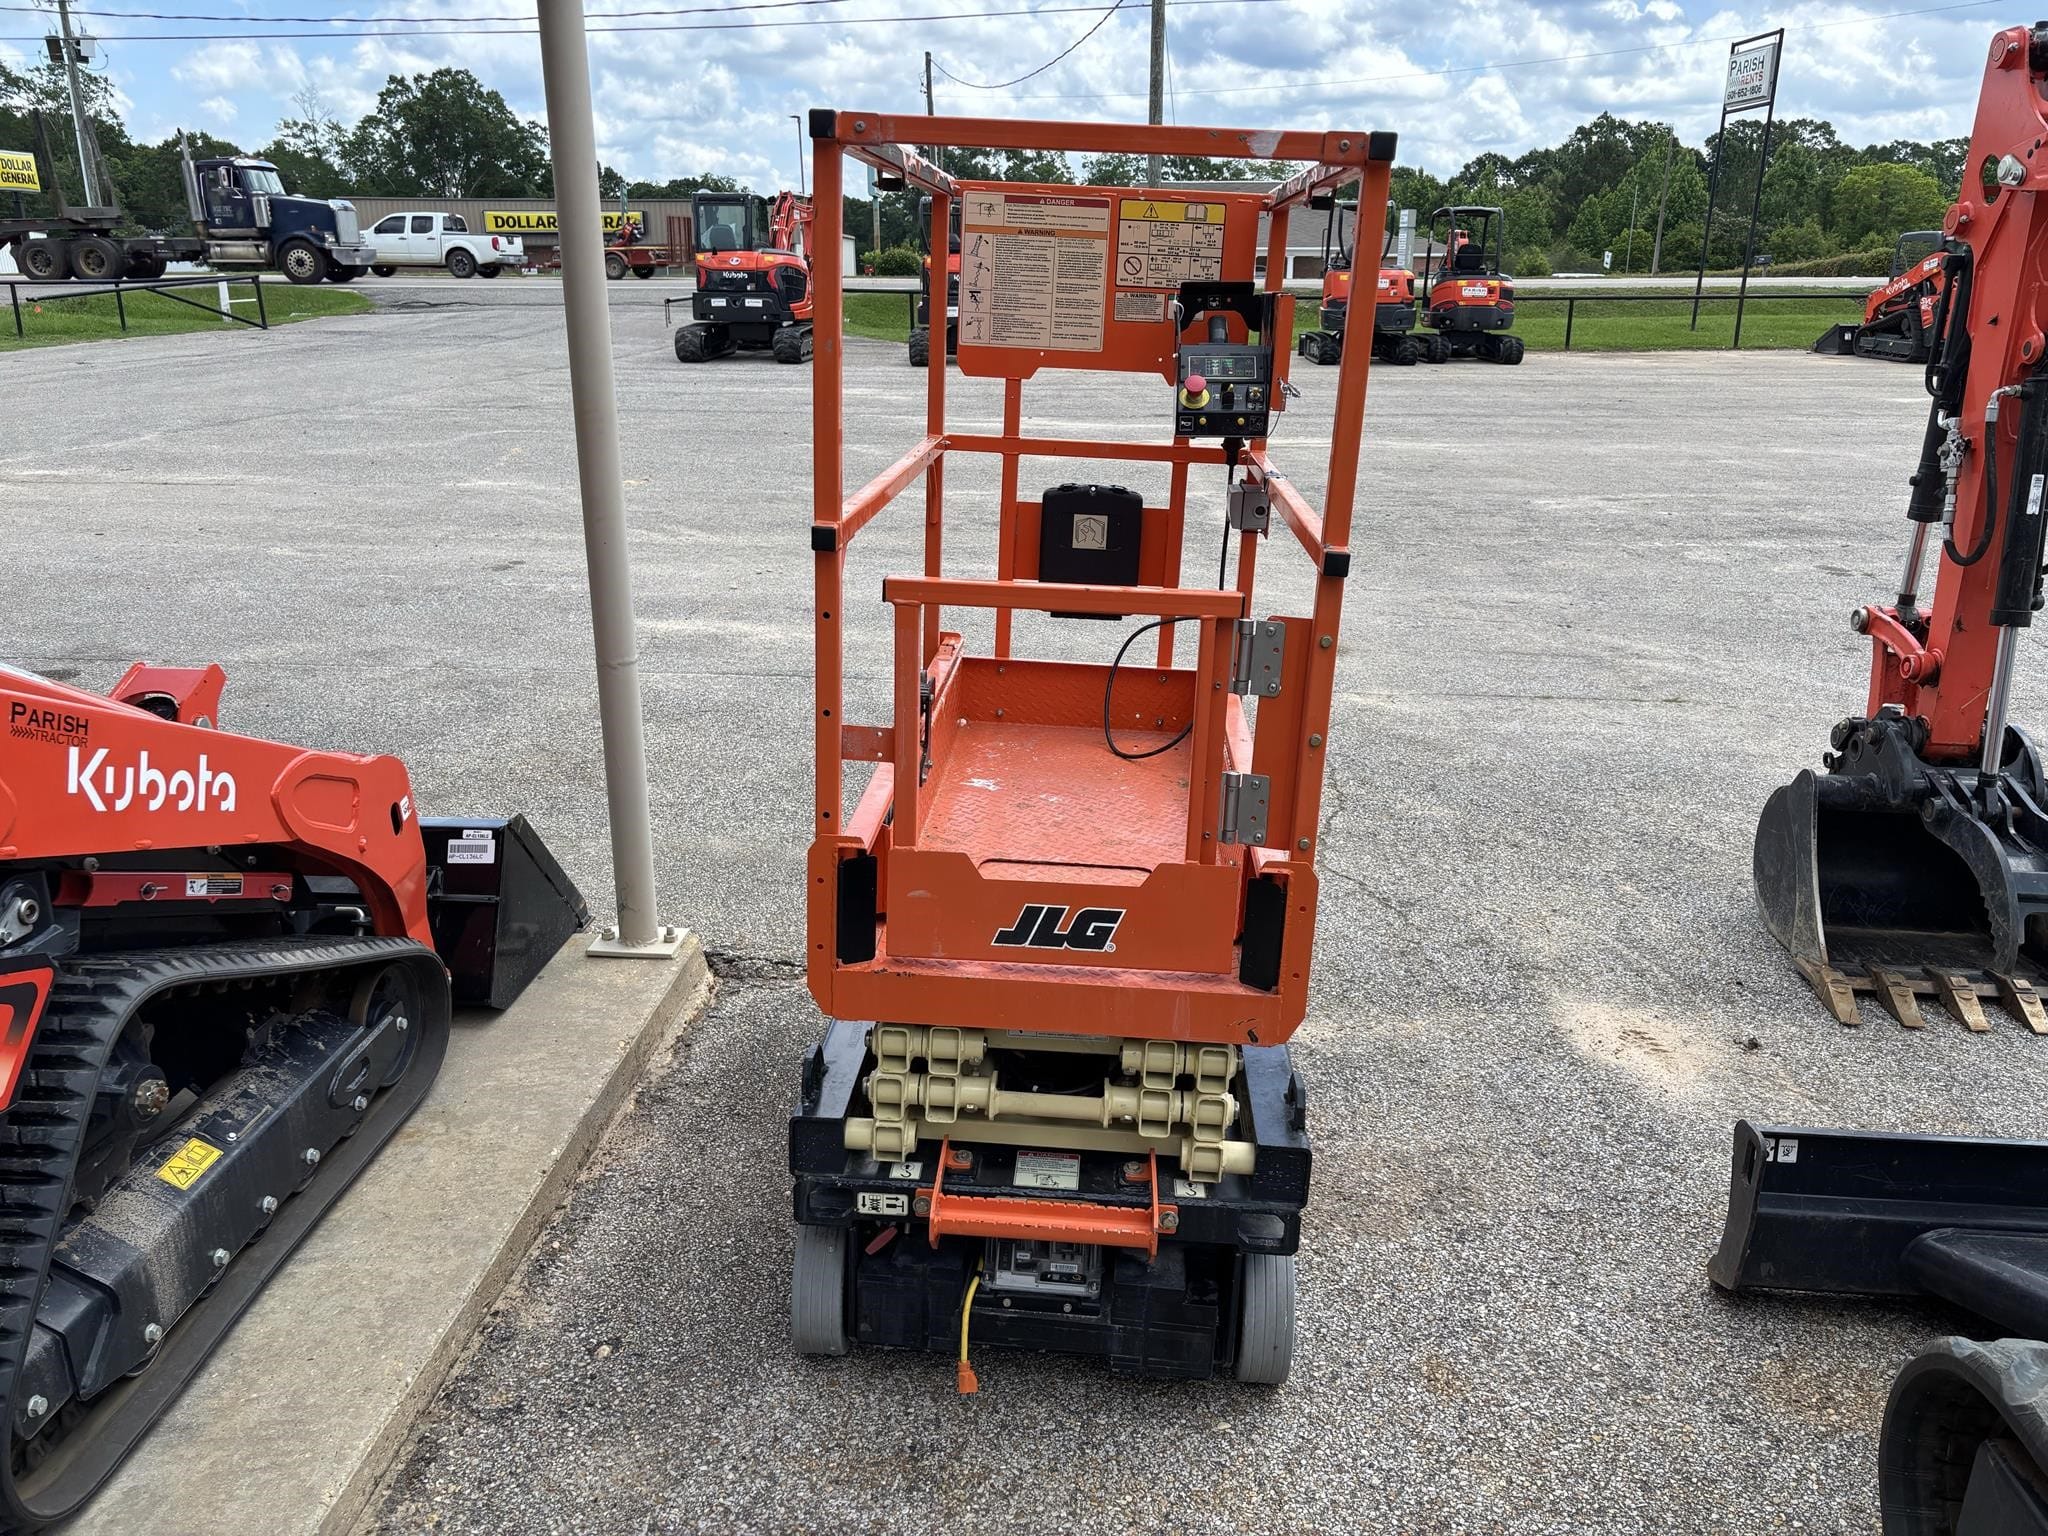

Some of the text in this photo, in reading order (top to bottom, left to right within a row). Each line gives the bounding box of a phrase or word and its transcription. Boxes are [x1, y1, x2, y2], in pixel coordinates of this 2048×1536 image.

[1730, 55, 1765, 77] PARISH
[1740, 71, 1764, 86] RENTS
[1727, 84, 1763, 100] 601-652-1806
[1, 158, 33, 171] DOLLAR
[1, 171, 37, 185] GENERAL
[493, 215, 558, 229] DOLLAR
[722, 271, 749, 279] Kubota
[1885, 278, 1909, 295] Kubota
[10, 701, 89, 736] PARISH
[34, 728, 89, 748] TRACTOR
[67, 746, 236, 812] Kubota
[990, 903, 1127, 952] JLG
